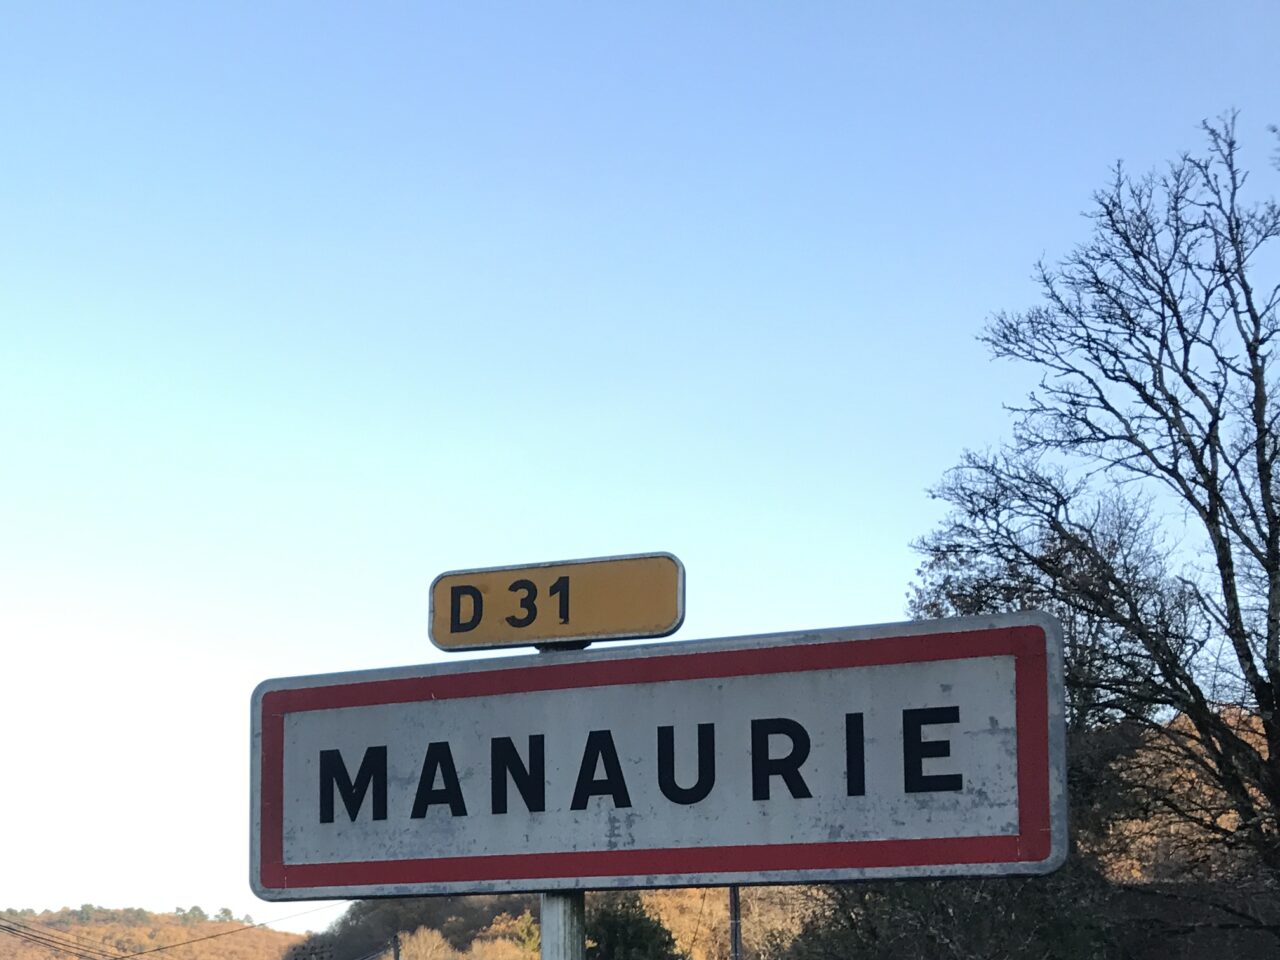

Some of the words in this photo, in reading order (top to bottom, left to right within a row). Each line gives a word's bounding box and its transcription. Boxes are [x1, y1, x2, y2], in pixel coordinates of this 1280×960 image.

[450, 585, 484, 634] D
[504, 576, 570, 629] 31
[319, 705, 964, 825] MANAURIE
